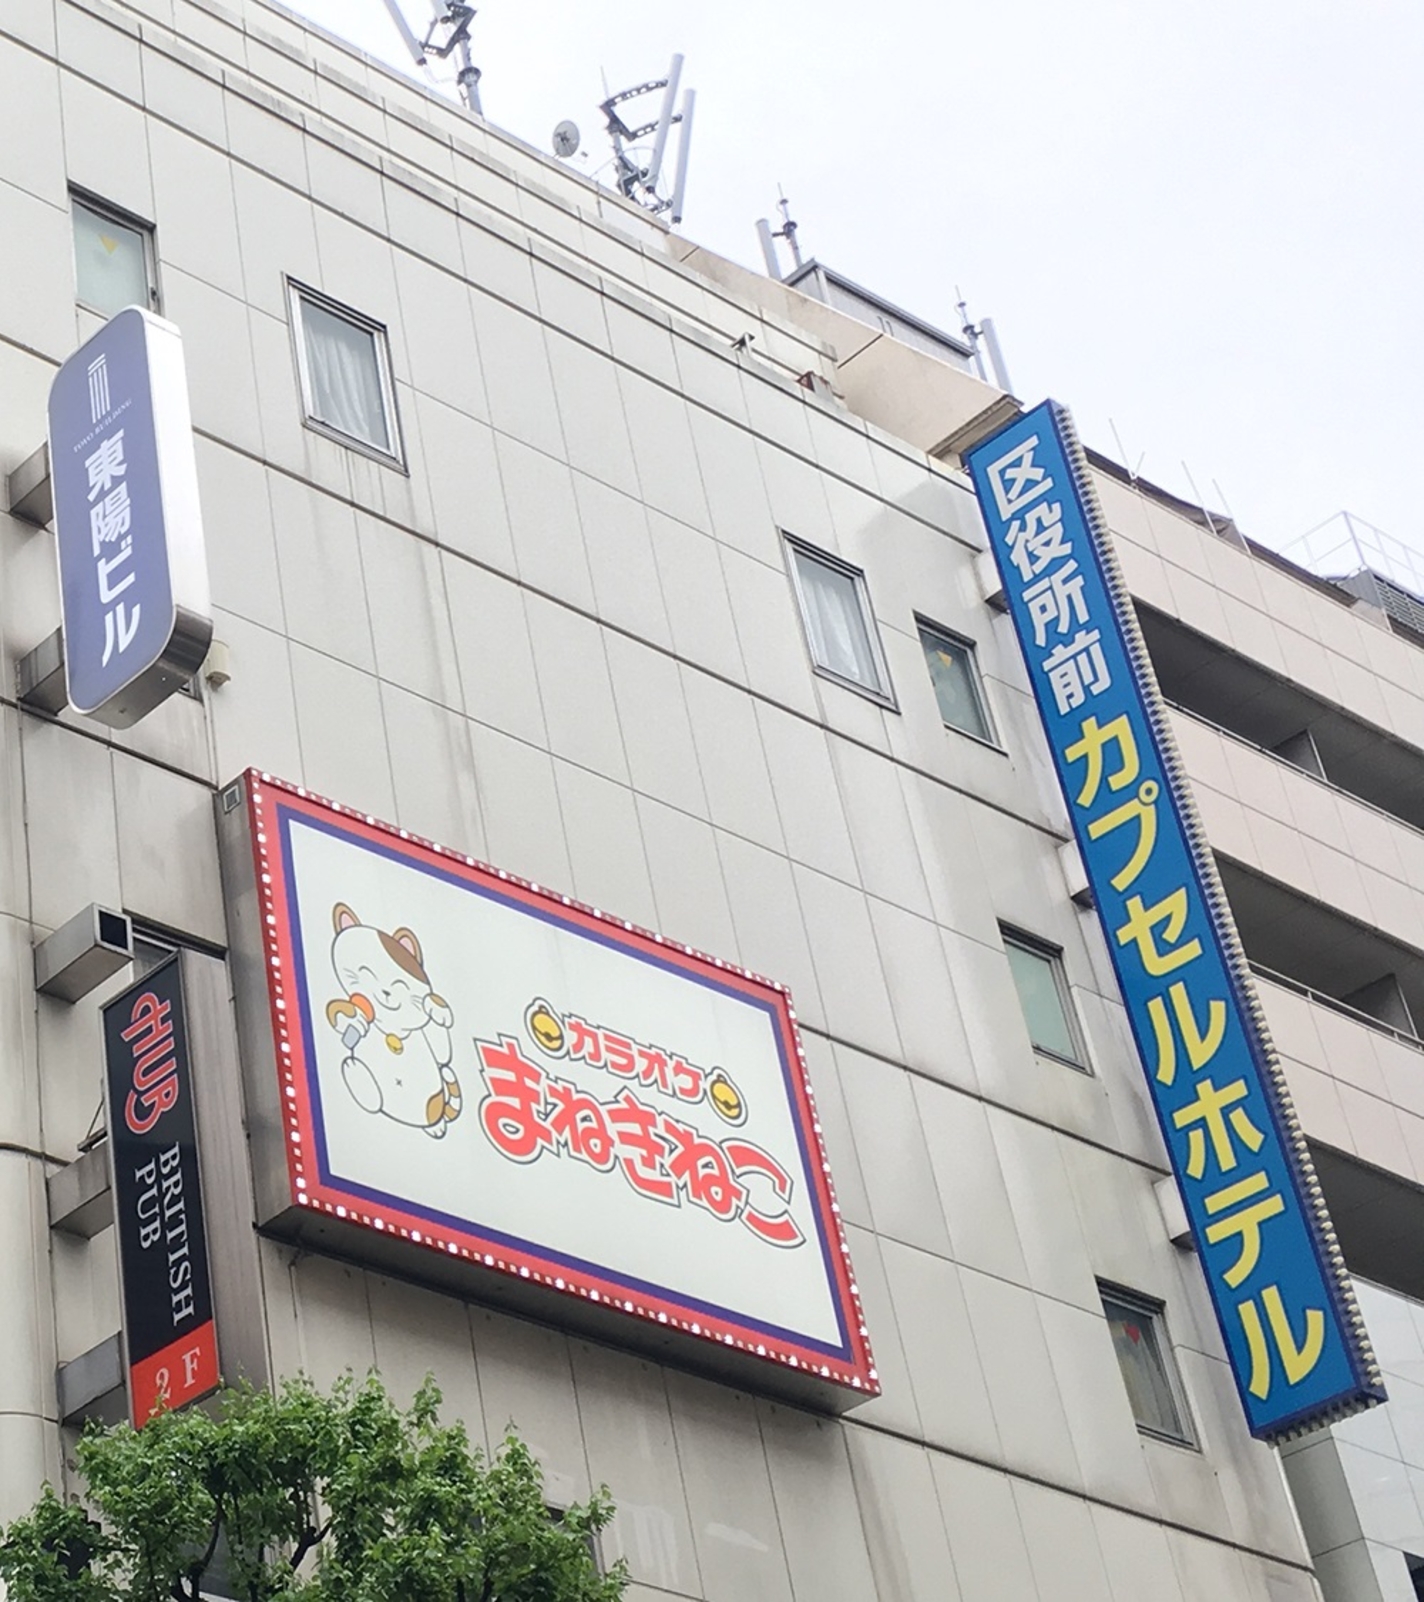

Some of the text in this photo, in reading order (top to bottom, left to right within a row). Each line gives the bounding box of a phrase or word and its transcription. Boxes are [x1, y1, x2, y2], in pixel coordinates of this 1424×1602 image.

[84, 429, 142, 668] 東陽ビル
[120, 990, 180, 1135] HUB
[566, 1017, 704, 1100] カラオケ
[134, 1157, 162, 1249] PUB
[477, 1037, 802, 1245] まねきねこ
[159, 1143, 195, 1327] BRITISH
